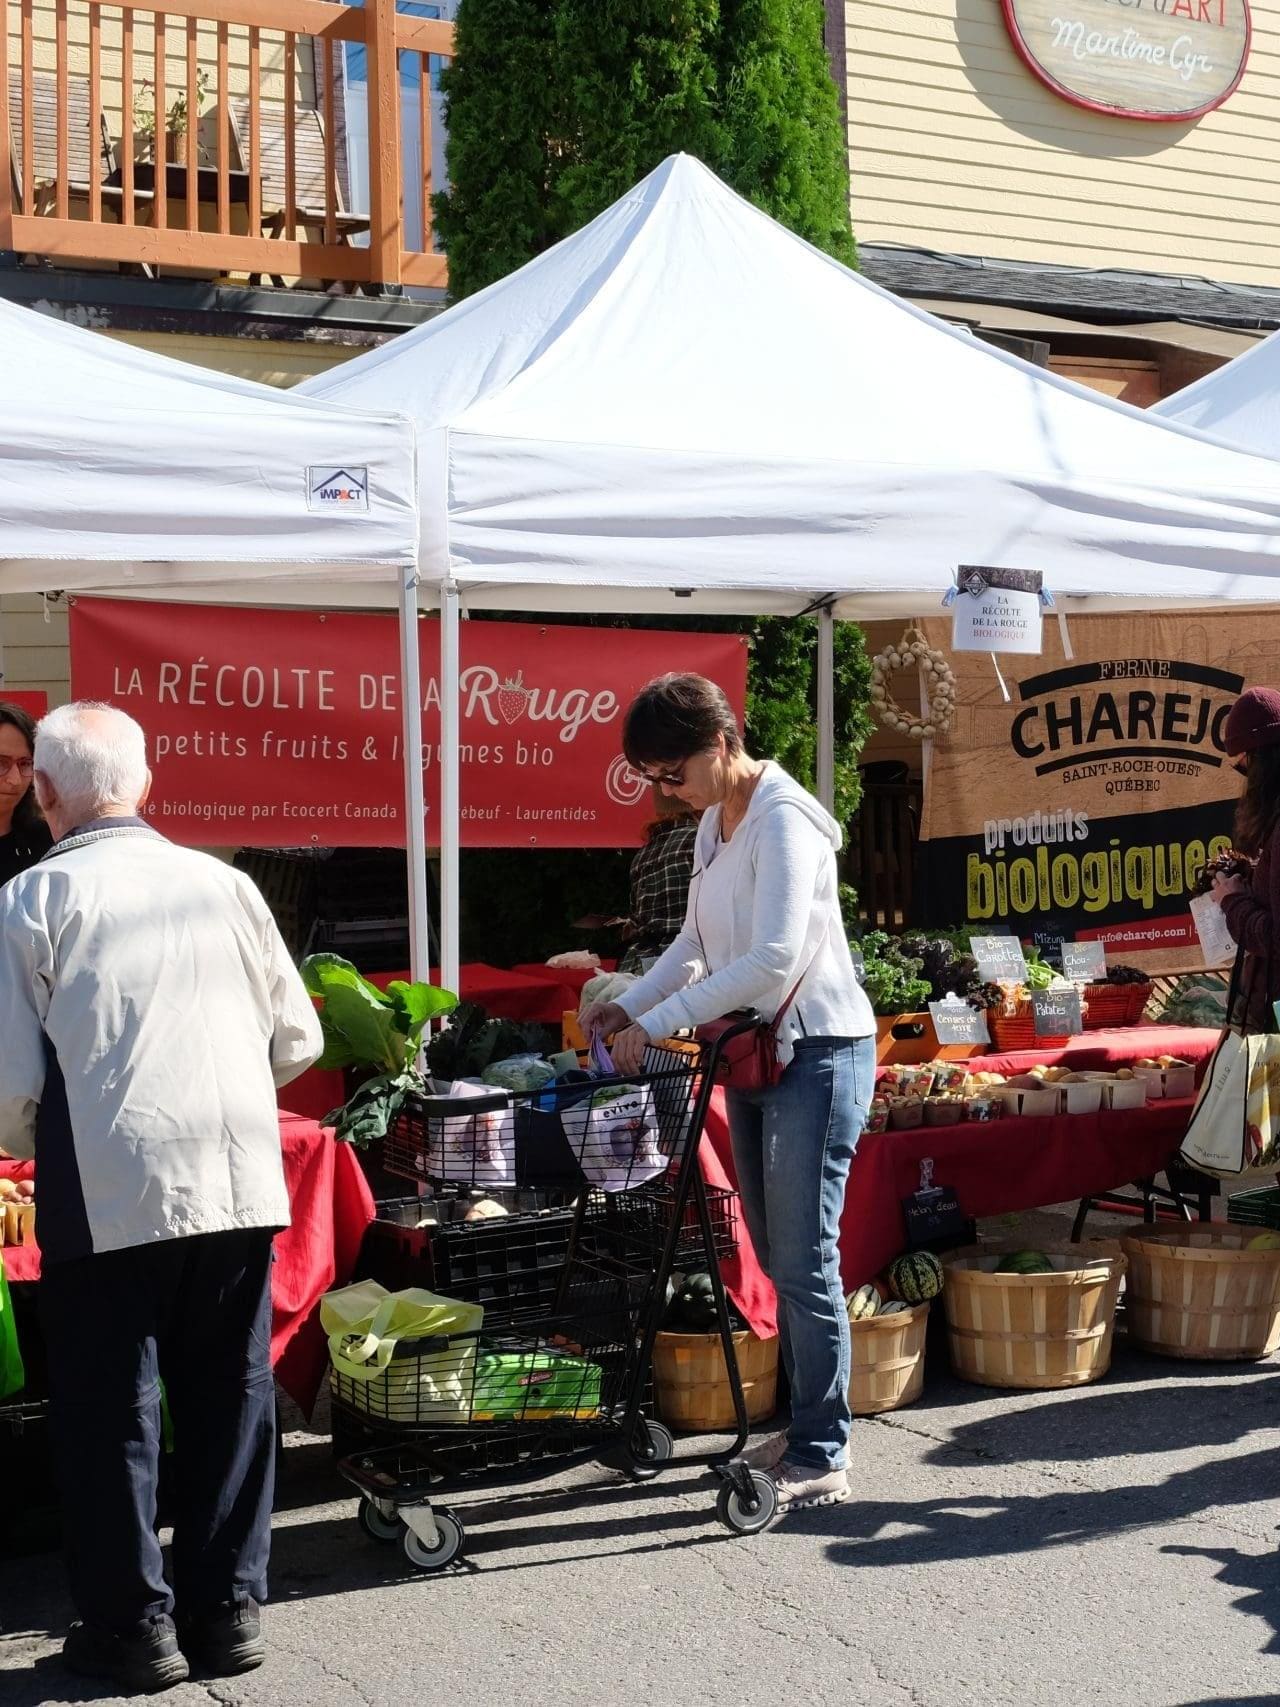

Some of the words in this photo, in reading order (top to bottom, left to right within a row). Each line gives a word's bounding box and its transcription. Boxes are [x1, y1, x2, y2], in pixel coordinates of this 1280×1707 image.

[1051, 17, 1166, 65] Martine
[1170, 35, 1213, 81] Cyr
[997, 596, 1009, 604] LA
[982, 605, 1021, 617] RÉCOLTE
[972, 617, 984, 626] DE
[986, 618, 998, 627] LA
[1000, 619, 1028, 628] ROUGE
[973, 629, 1025, 640] BIOLOGIQUE
[114, 667, 143, 696] LA
[158, 657, 335, 710] RÉCOLTE
[360, 674, 396, 711] DE
[419, 677, 442, 712] A
[156, 731, 247, 762] petits
[262, 731, 348, 760] fruits
[362, 736, 378, 761] &
[516, 740, 553, 766] bio
[1062, 761, 1201, 784] SAINT-ROCH-OUEST
[1105, 777, 1161, 795] QUÉBEC
[162, 800, 246, 820] biologique
[252, 805, 276, 820] par
[284, 802, 339, 817] Ecocert
[345, 803, 397, 818] Canada
[516, 805, 597, 821] Laurentides
[984, 808, 1089, 855] produits
[1035, 1002, 1066, 1016] Patates
